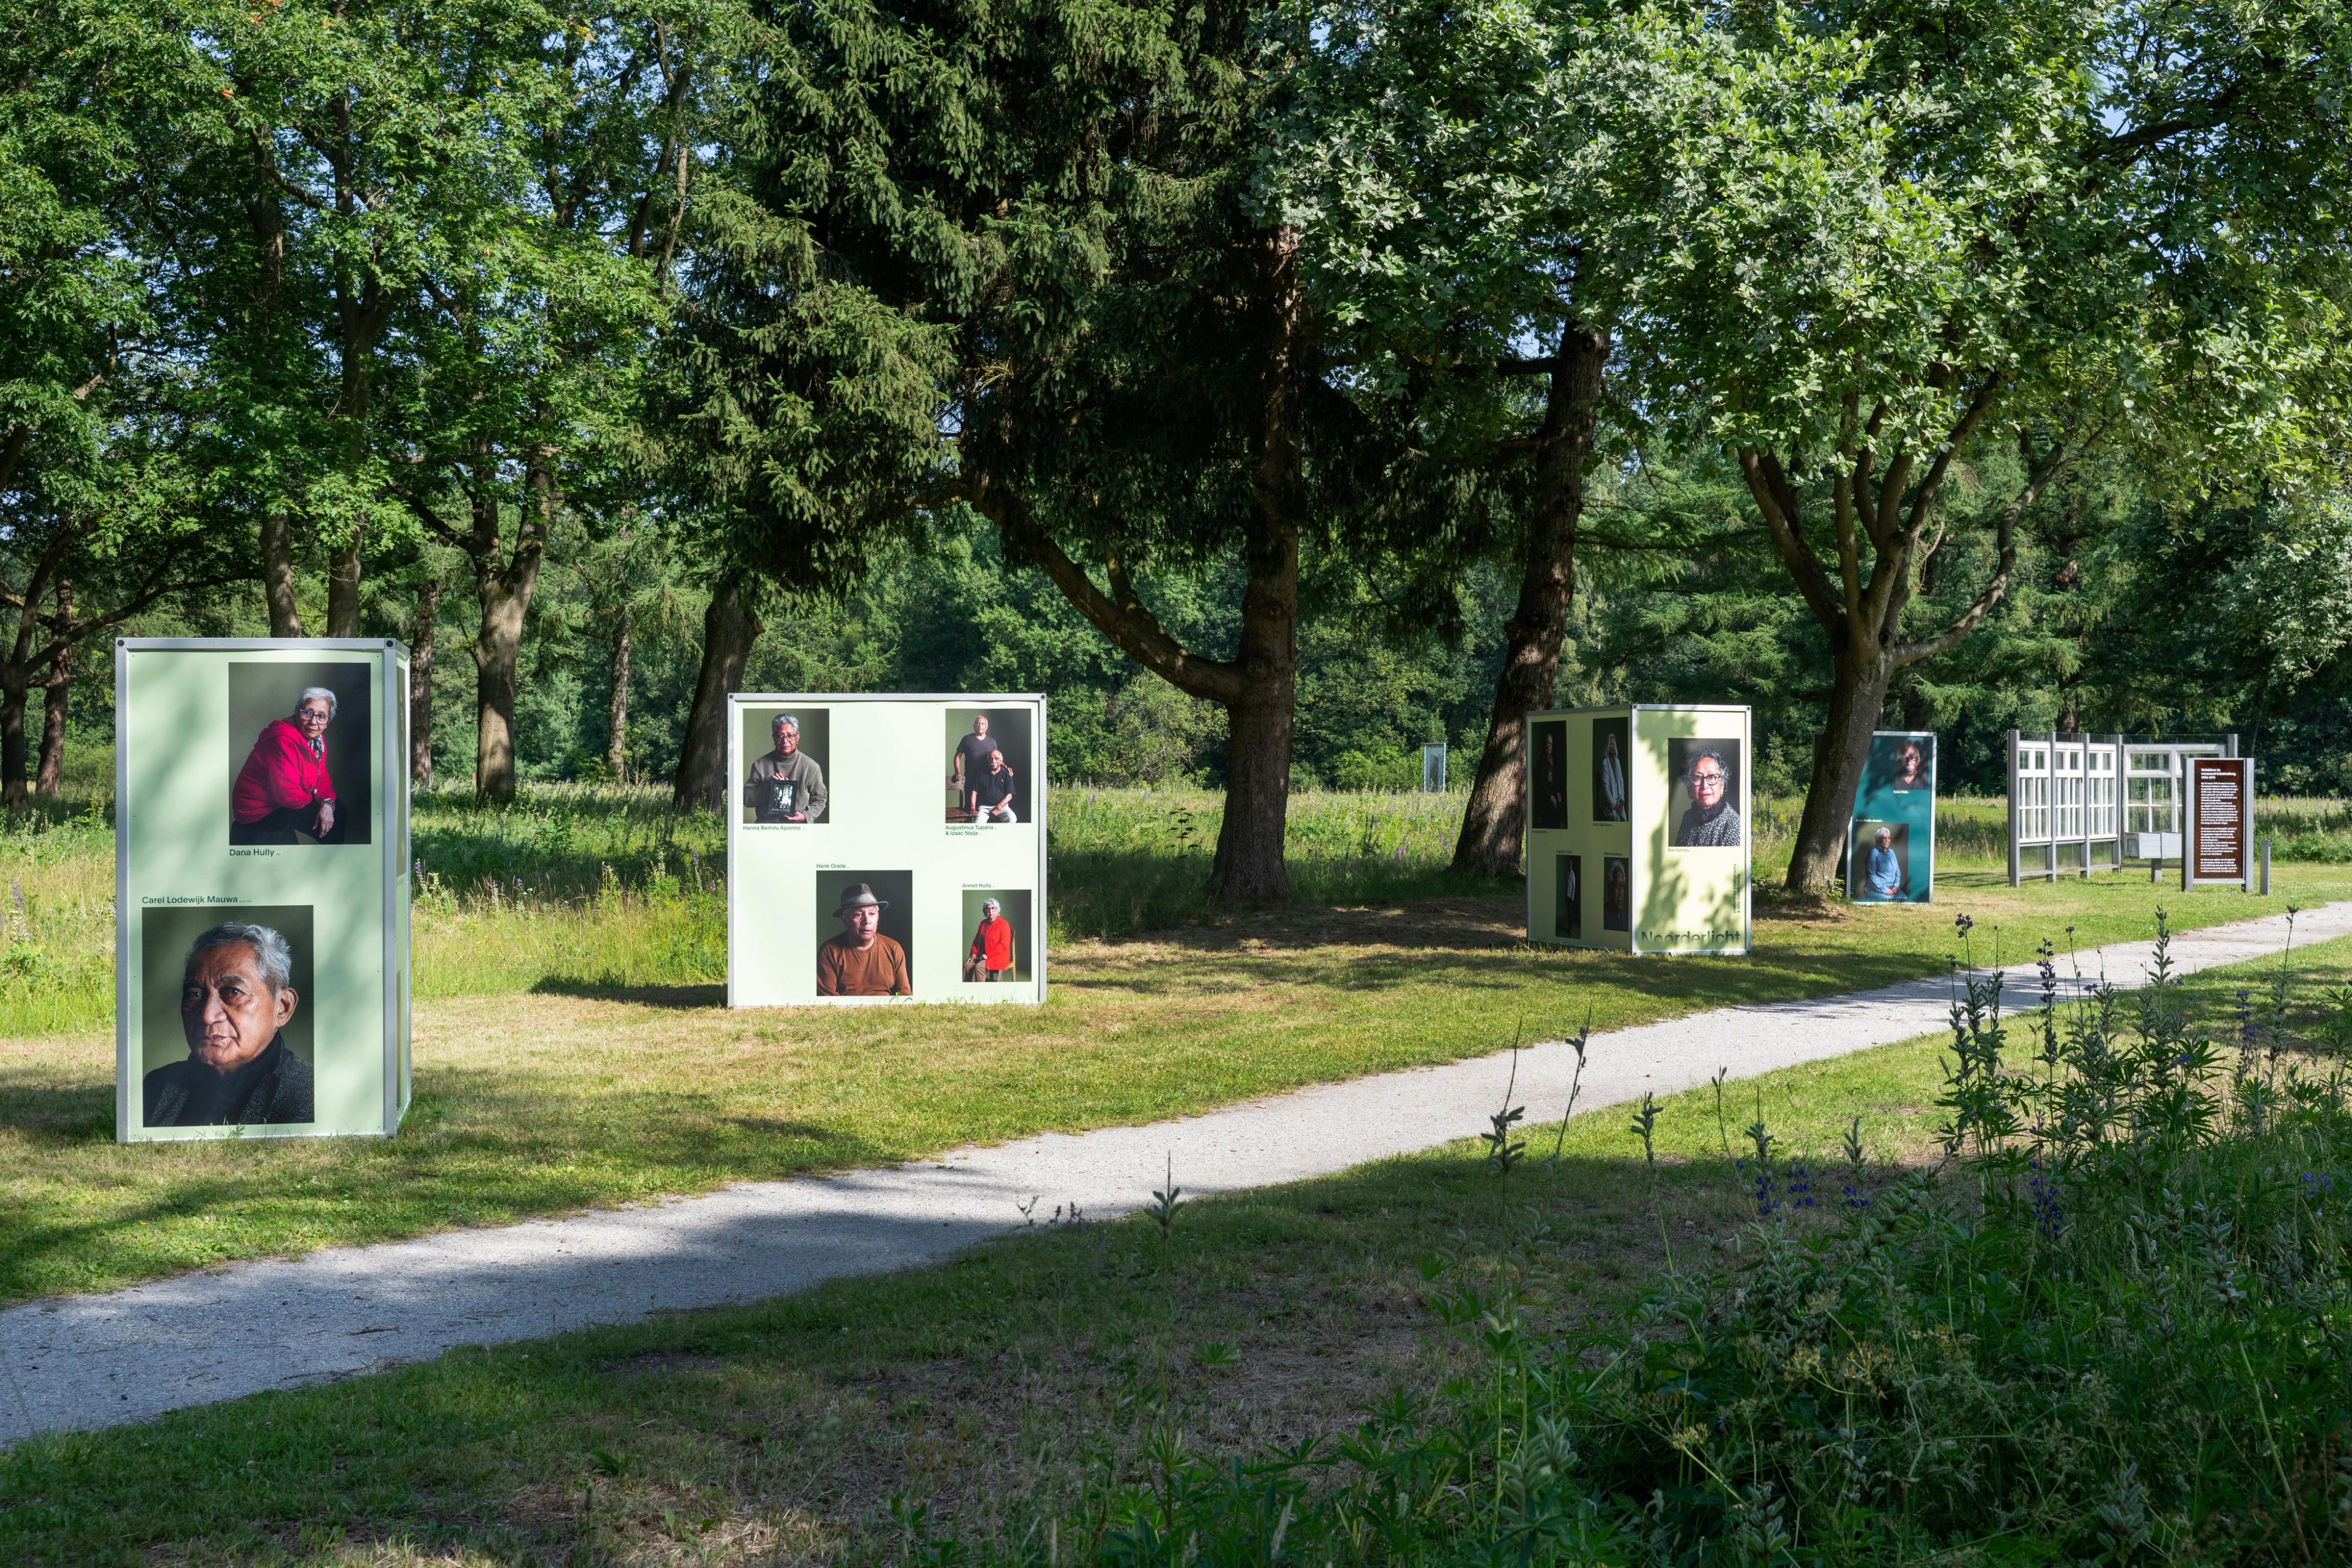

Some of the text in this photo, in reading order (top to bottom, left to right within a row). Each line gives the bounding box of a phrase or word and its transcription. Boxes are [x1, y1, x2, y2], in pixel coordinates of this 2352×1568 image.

[253, 849, 275, 857] Hully
[167, 896, 205, 905] Lodewijk
[1641, 931, 1740, 944] Noorderlicht
